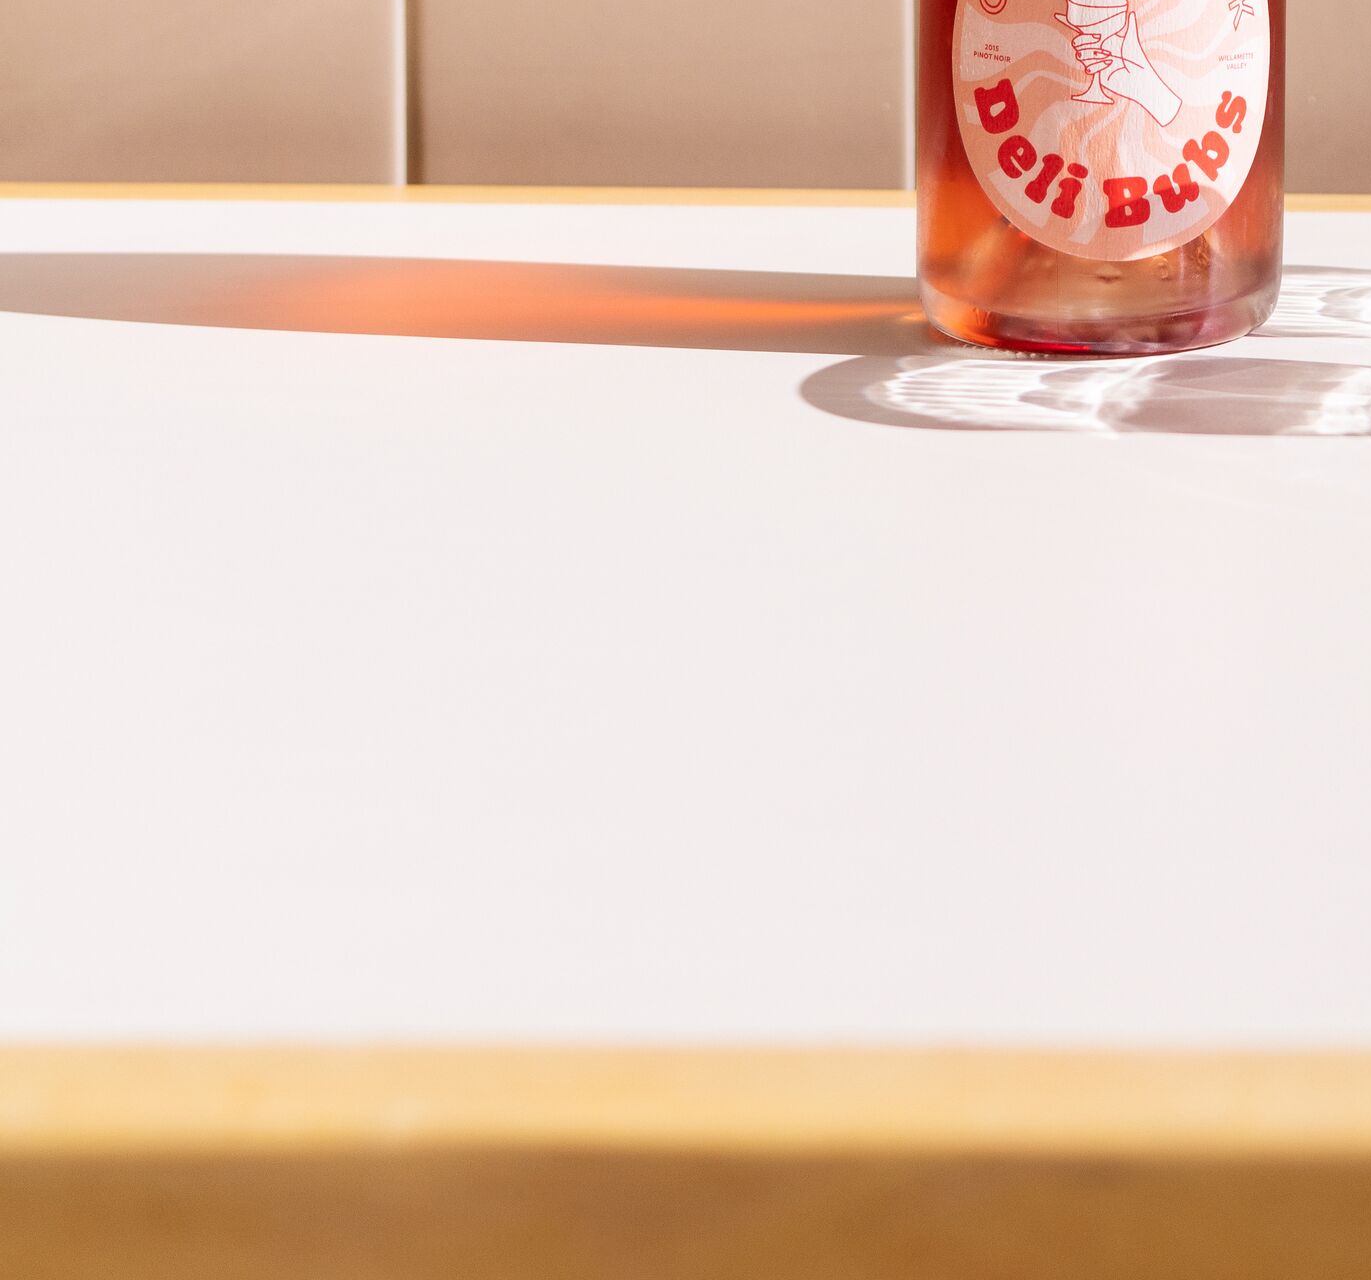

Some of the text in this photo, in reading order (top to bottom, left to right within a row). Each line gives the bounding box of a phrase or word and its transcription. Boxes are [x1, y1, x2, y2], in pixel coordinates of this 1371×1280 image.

[973, 50, 1011, 63] PINOT NOIR
[974, 78, 1247, 228] Deli Bubs
